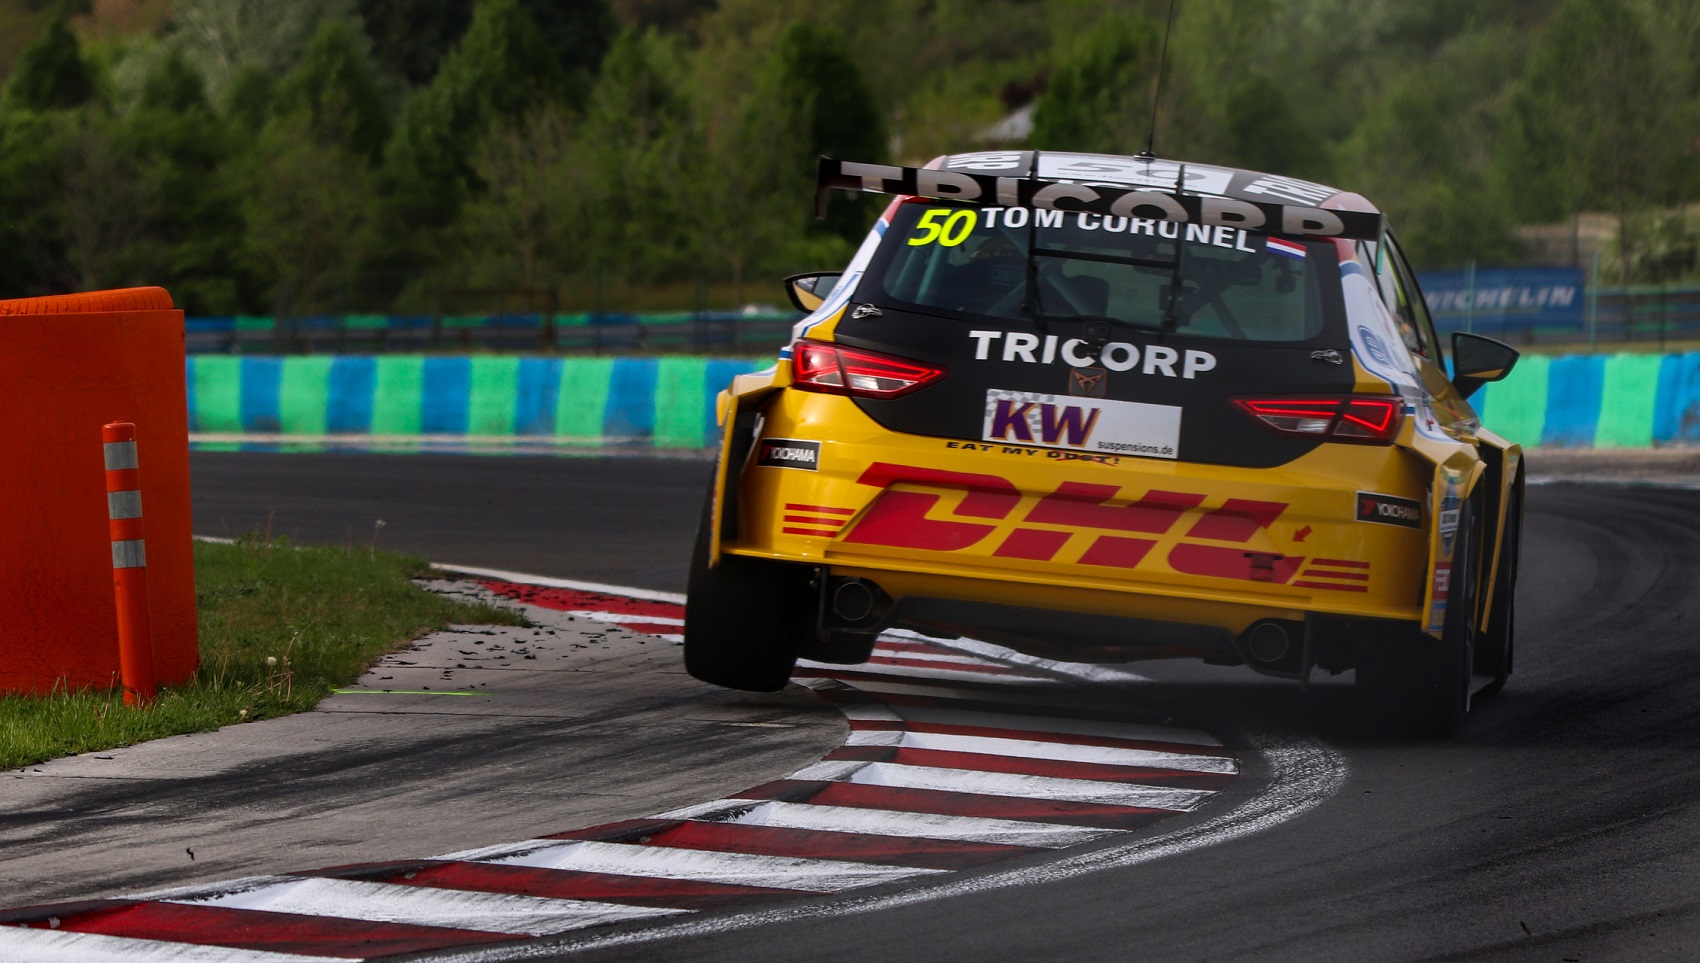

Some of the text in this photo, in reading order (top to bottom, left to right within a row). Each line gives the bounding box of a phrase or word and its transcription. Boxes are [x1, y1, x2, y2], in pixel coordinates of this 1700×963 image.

[908, 209, 977, 247] 50
[981, 206, 1065, 229] TOM
[968, 330, 1217, 379] TRICORP
[989, 399, 1102, 447] KW
[946, 441, 994, 451] EAT
[1002, 446, 1039, 456] MY
[1097, 440, 1174, 456] suspensions.de
[843, 461, 1306, 585] DHL
